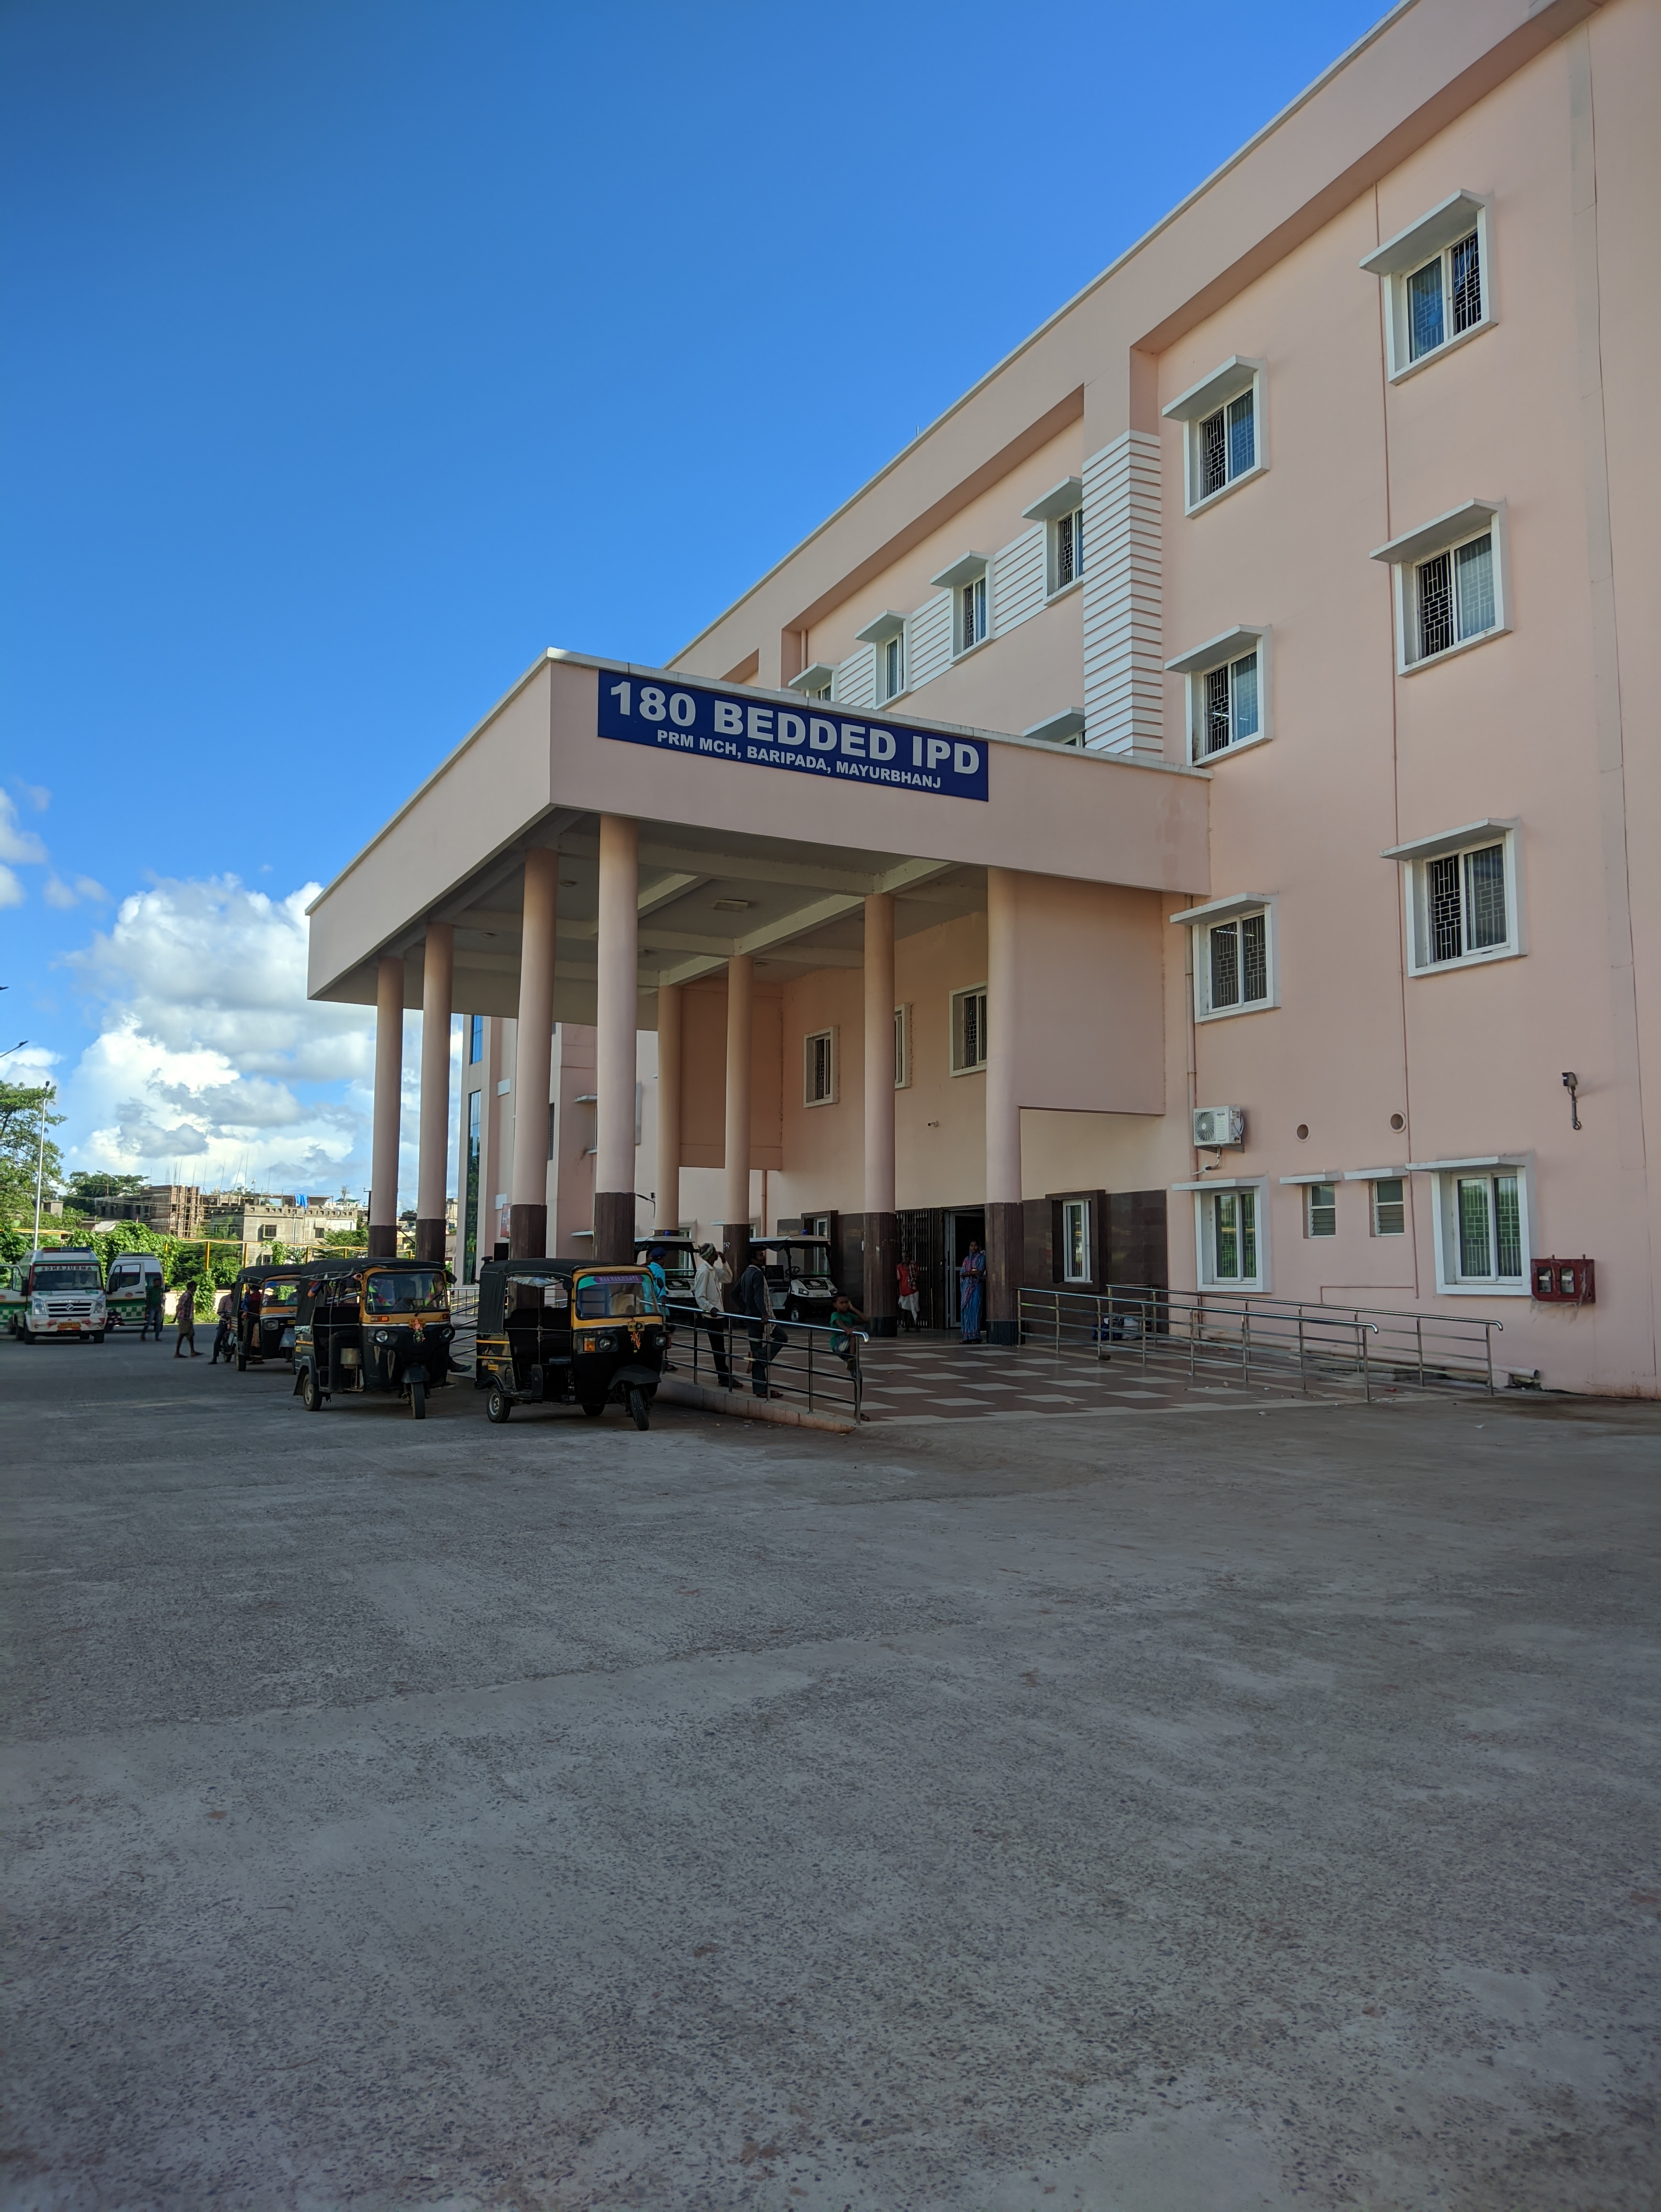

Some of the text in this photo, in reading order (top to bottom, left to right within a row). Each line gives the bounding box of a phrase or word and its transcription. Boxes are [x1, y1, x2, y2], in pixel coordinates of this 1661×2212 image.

[610, 681, 979, 774] 180 BEDDED IPD
[657, 729, 941, 788] PRM MCH, BARIPADA, MAYURBHANJ
